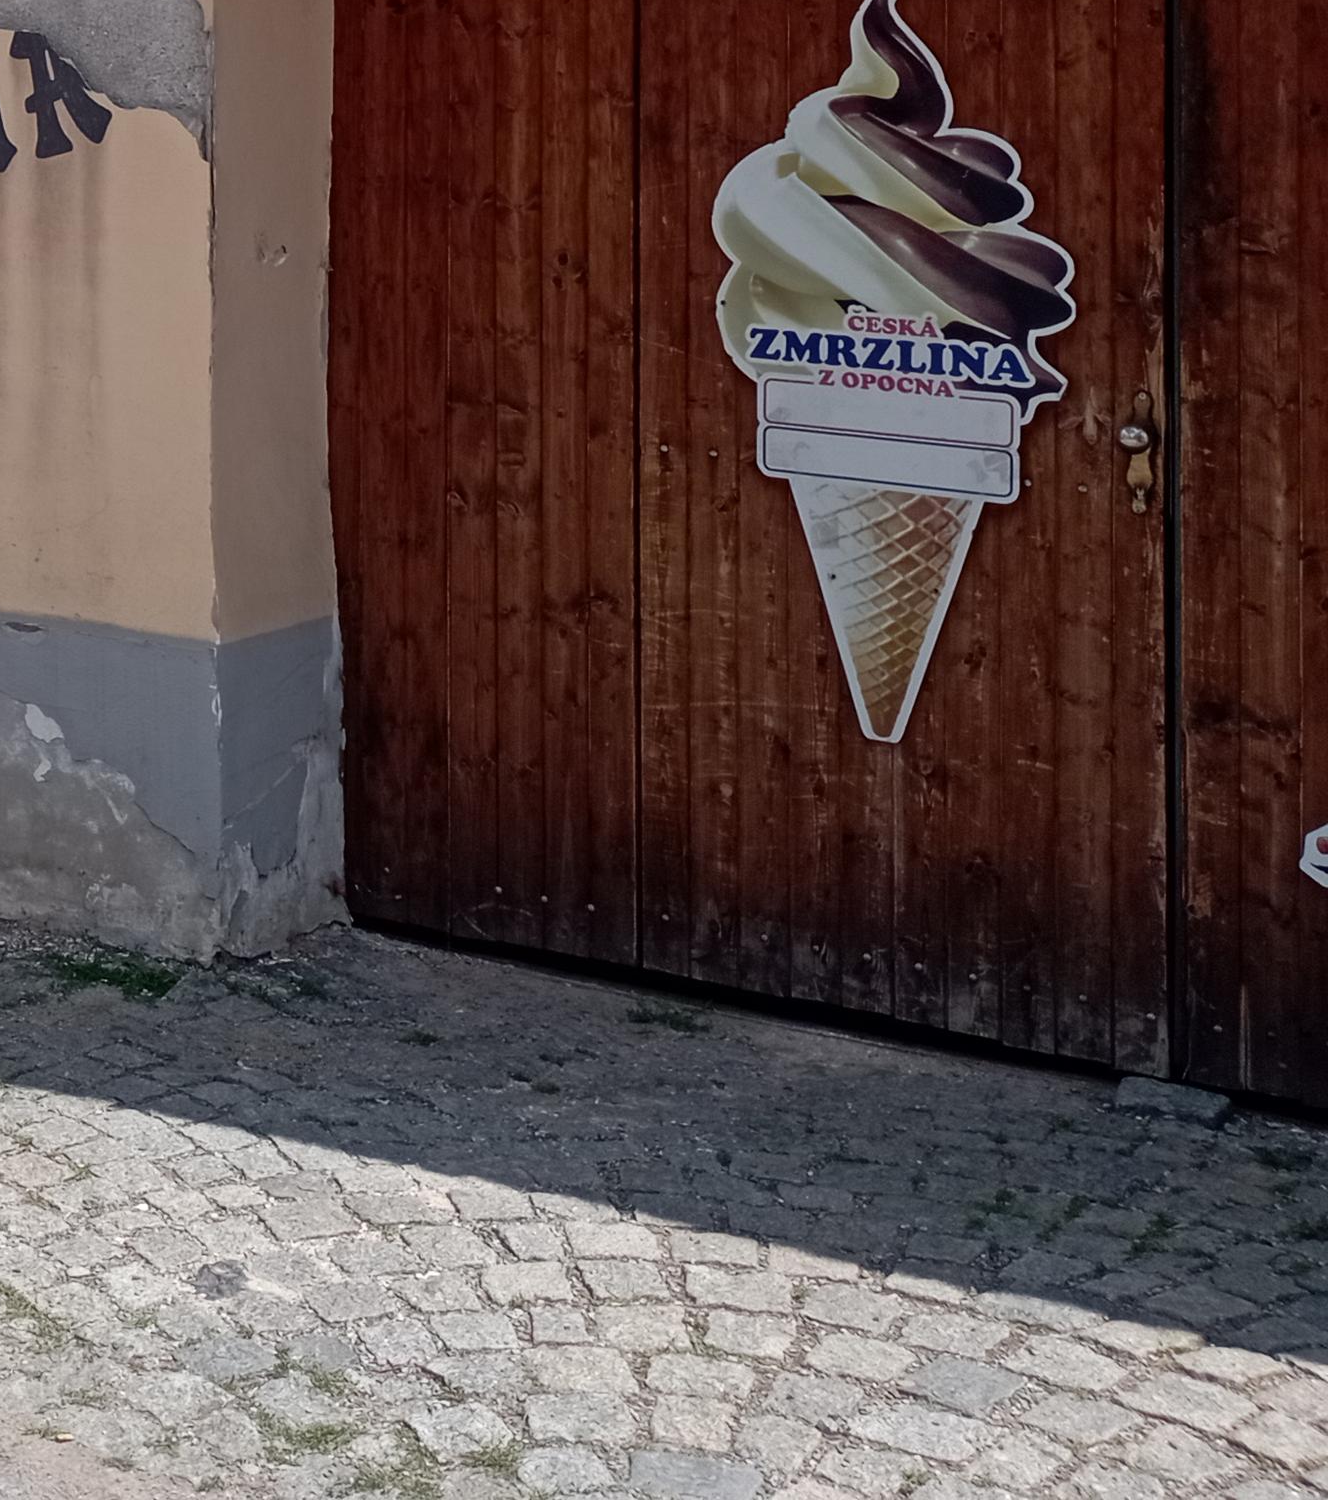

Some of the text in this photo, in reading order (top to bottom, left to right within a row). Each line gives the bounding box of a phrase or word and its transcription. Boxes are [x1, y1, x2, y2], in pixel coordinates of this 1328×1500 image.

[847, 308, 939, 338] ČESKÁ
[749, 327, 1030, 382] ZMRZLINA
[818, 369, 835, 386] Z
